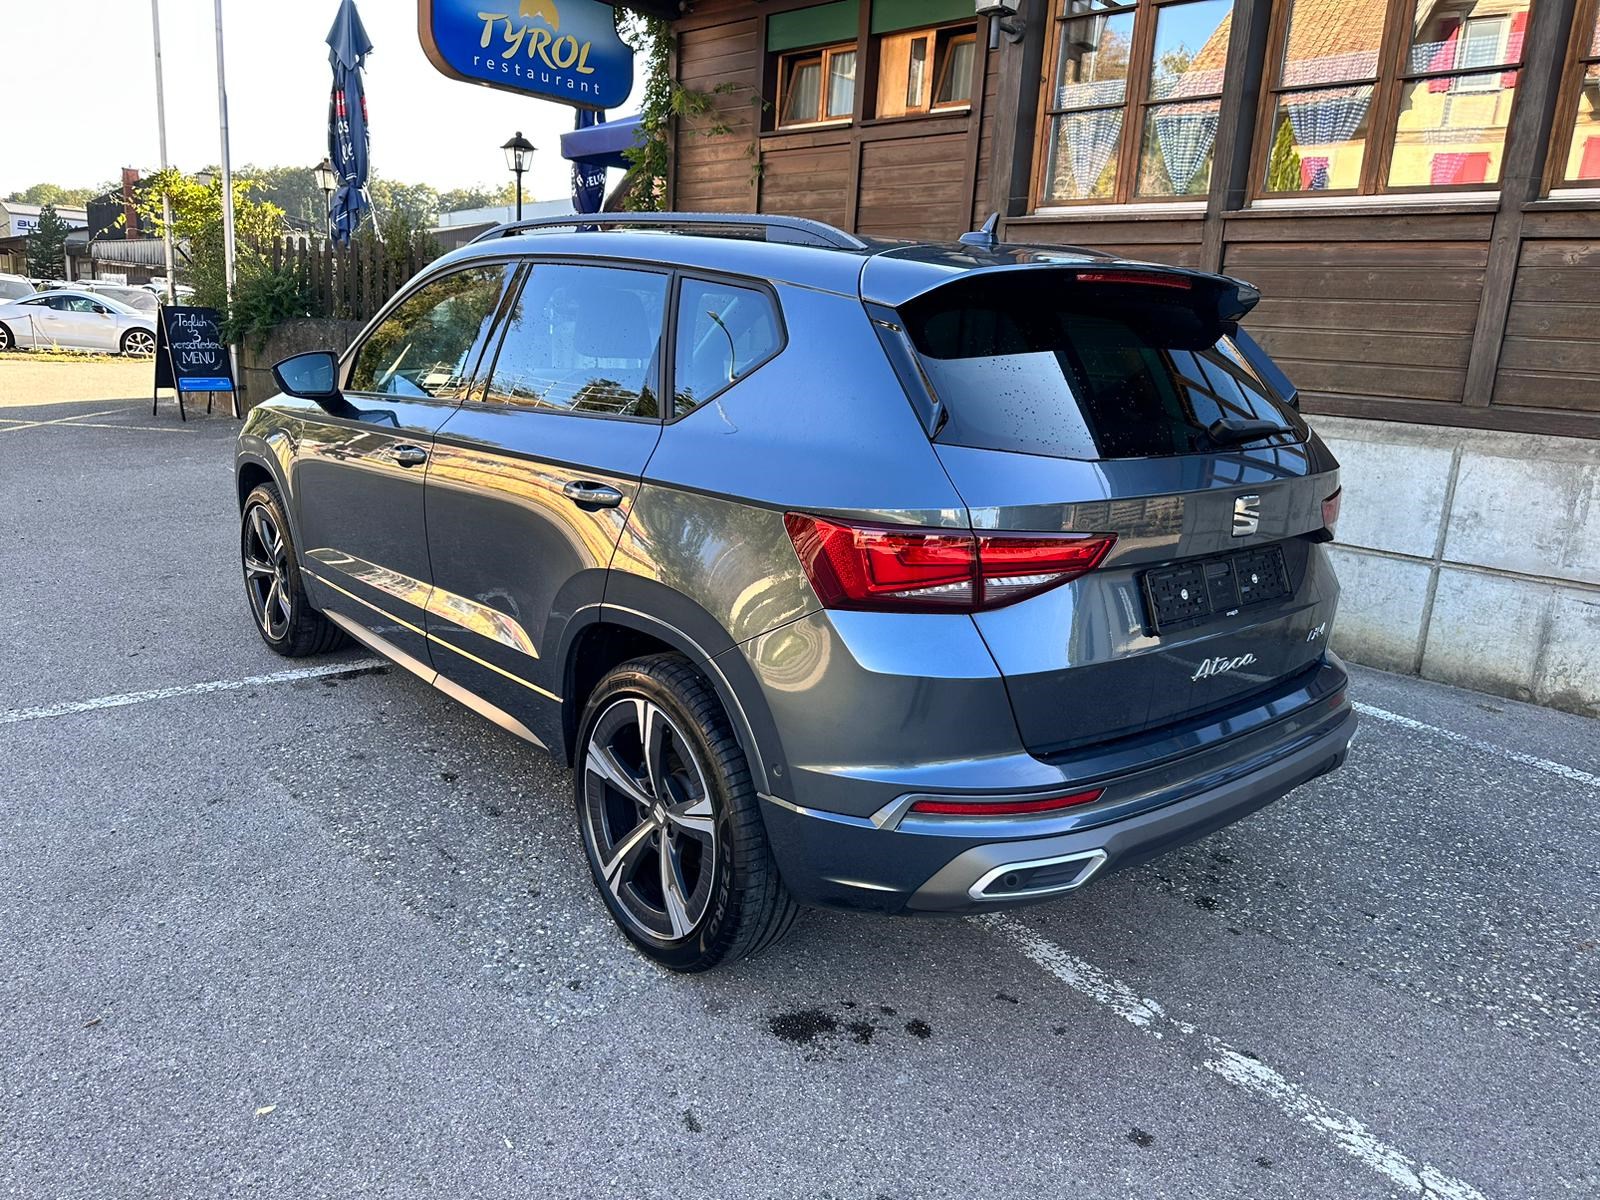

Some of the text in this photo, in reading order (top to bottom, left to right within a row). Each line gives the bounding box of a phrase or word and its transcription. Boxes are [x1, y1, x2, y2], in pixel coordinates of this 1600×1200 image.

[477, 11, 595, 75] TYROL
[473, 55, 600, 95] restaurant
[192, 330, 202, 342] 3
[1191, 653, 1257, 682] Ateca
